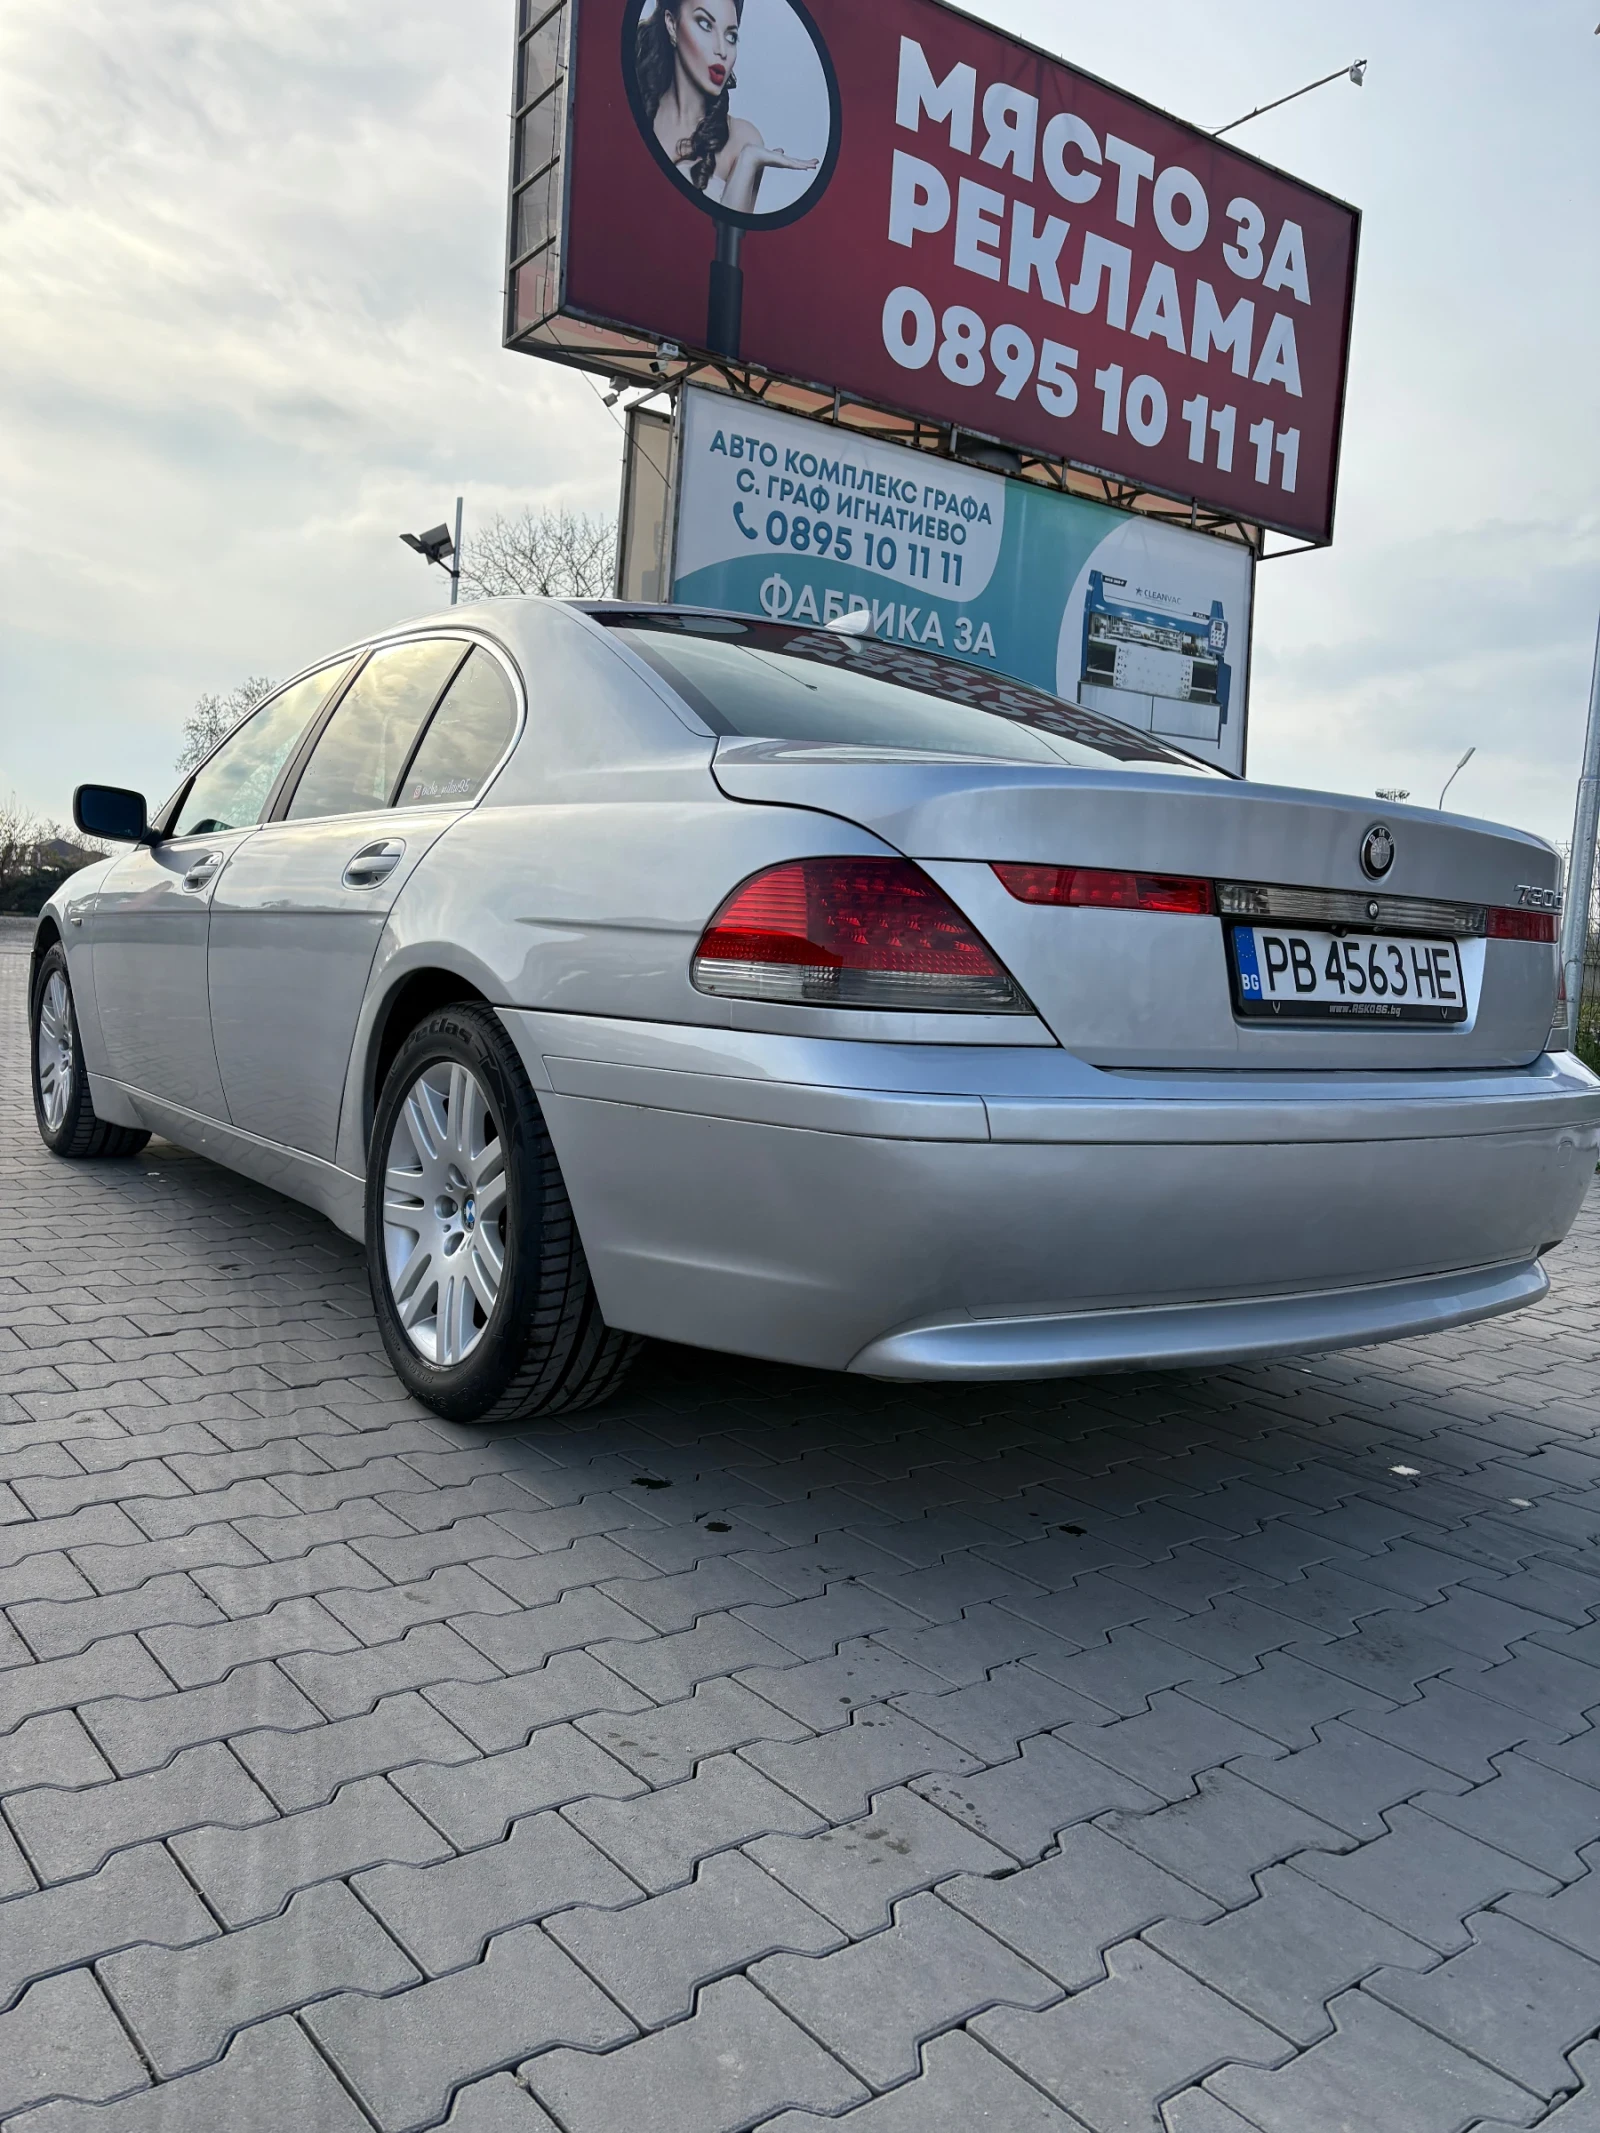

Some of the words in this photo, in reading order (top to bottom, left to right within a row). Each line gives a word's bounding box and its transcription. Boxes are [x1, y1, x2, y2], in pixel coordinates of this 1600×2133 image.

[895, 35, 1209, 252] МЯСТО
[1222, 197, 1311, 305] ЗА
[887, 149, 1303, 398] РЕКЛАМА
[882, 286, 1079, 418] 0895
[1095, 363, 1168, 447] 10
[1182, 394, 1237, 472] 11
[1248, 417, 1300, 493] 11
[709, 429, 779, 467] АВТО
[785, 447, 918, 504] КОМПЛЕКС
[923, 485, 992, 525] ГРАФА
[736, 468, 760, 496] С.
[767, 475, 830, 515] ГРАФ
[837, 492, 967, 546] ИГНАТИЕВО
[766, 510, 852, 561] 0895
[864, 533, 897, 571] 10
[908, 543, 930, 579] 11
[940, 550, 963, 587] 11
[953, 616, 997, 658] ЗА
[1241, 973, 1260, 992] BG
[1262, 936, 1317, 993] PB
[1325, 940, 1409, 997] 4563
[1411, 946, 1457, 1000] HE
